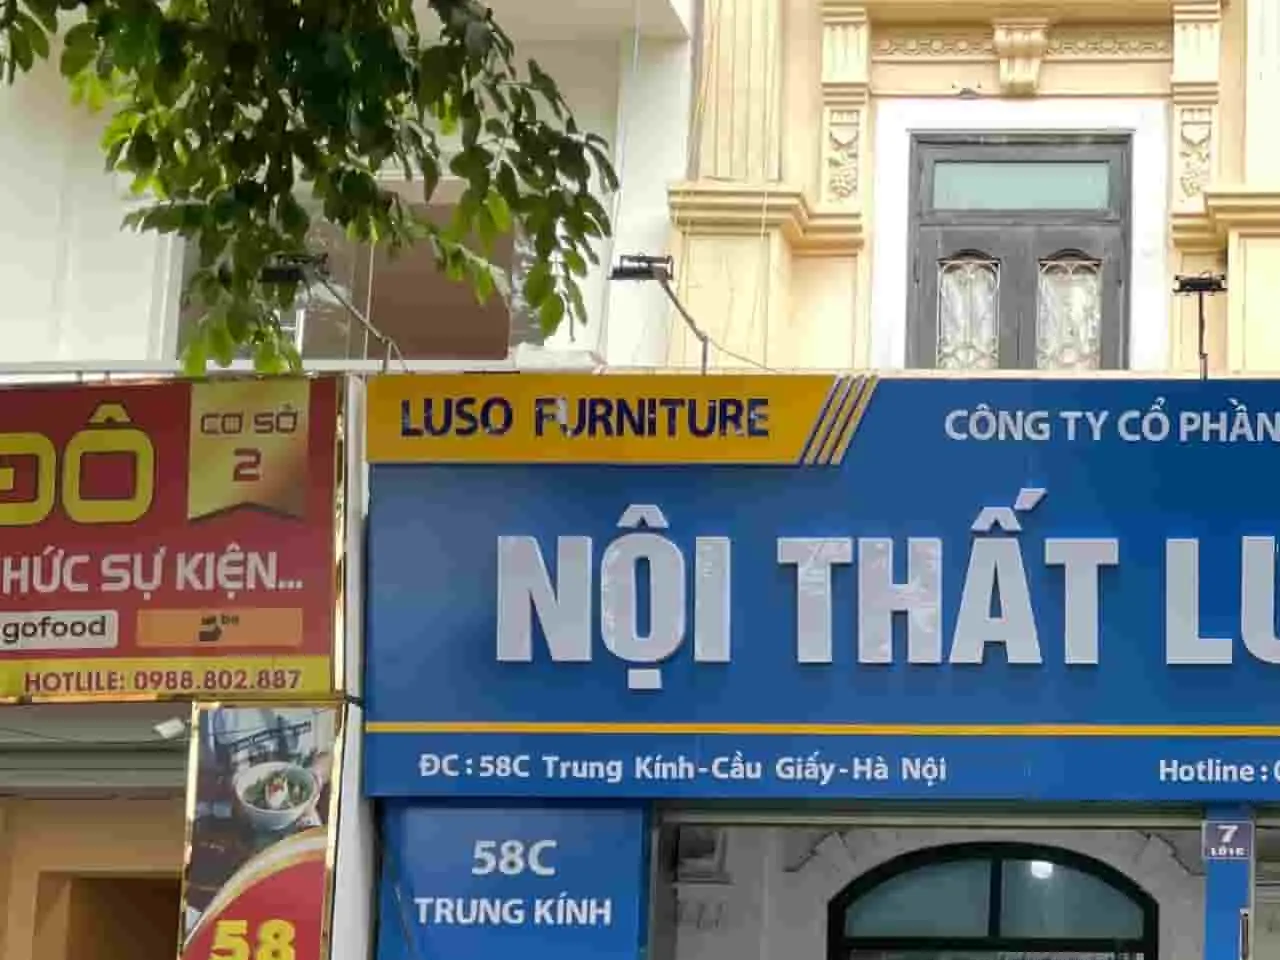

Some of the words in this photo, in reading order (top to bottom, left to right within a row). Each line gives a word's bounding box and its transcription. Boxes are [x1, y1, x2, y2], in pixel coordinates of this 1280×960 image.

[400, 397, 513, 438] LUSO
[944, 404, 1050, 442] CÔNG
[1060, 410, 1109, 441] TY
[1117, 397, 1170, 442] CỔ
[233, 448, 261, 481] 2
[101, 547, 167, 599] SỰ
[496, 503, 732, 690] NỘI
[776, 487, 1119, 666] THẤT
[2, 615, 107, 643] gofood
[134, 669, 302, 691] 0988.802.887
[542, 755, 623, 783] Trung
[901, 755, 947, 787] Nội
[1217, 824, 1238, 843] 7
[471, 839, 557, 876] 58C
[414, 897, 526, 925] TRUNG
[534, 891, 612, 926] KÍNH
